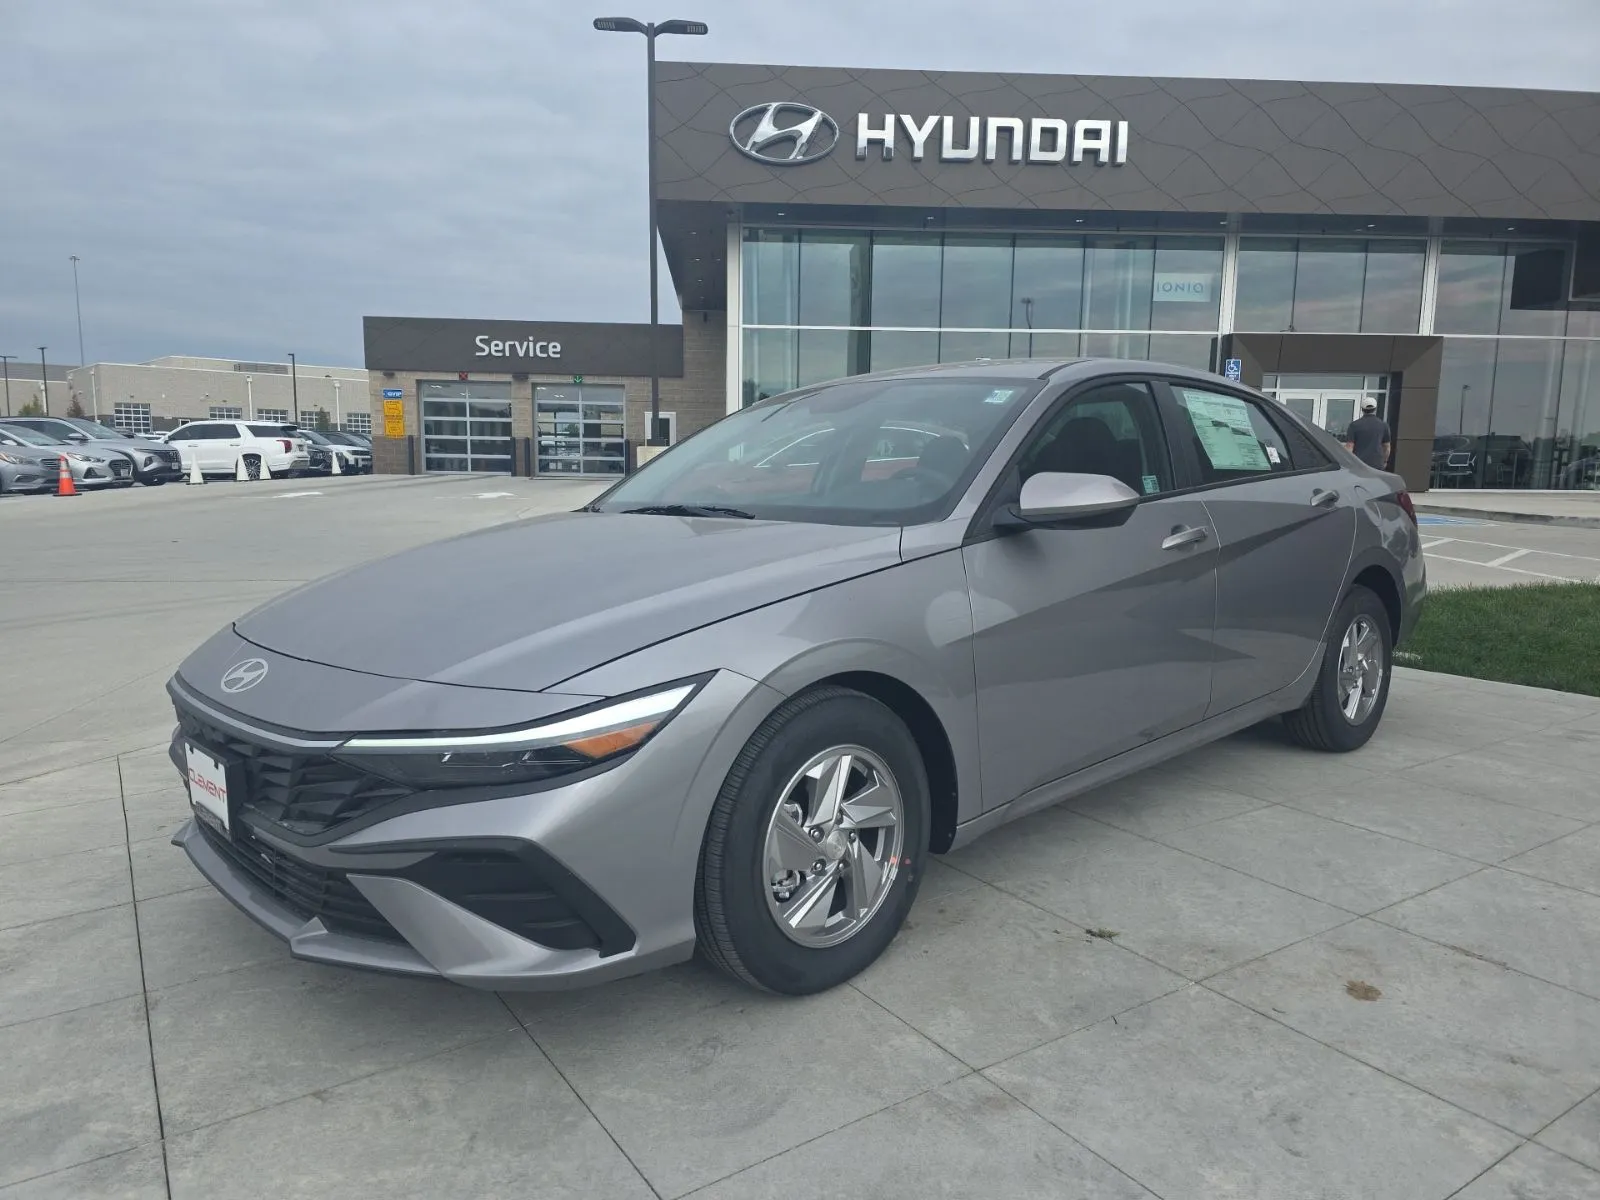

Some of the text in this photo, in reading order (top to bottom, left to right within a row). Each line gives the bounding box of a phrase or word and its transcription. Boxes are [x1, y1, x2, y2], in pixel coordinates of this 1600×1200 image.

[856, 113, 1128, 165] HYUNDAI
[1156, 281, 1204, 294] IONIQ
[475, 335, 562, 358] Service
[188, 768, 227, 803] CLEMENT
